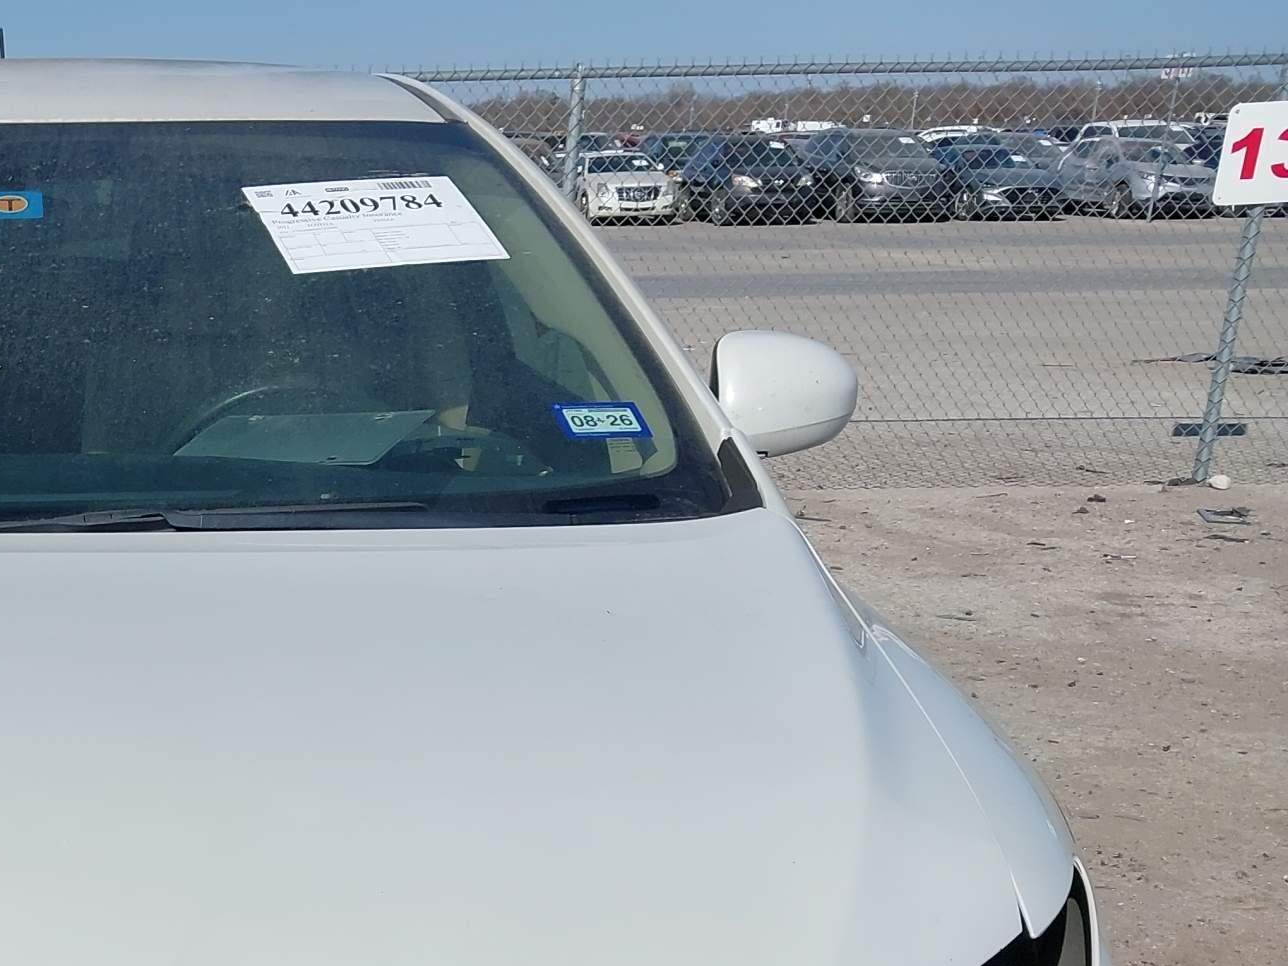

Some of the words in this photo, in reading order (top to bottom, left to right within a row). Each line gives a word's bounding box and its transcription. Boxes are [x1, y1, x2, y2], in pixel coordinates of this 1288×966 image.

[280, 193, 443, 218] 44209784
[570, 415, 598, 428] 08
[606, 414, 633, 426] 26
